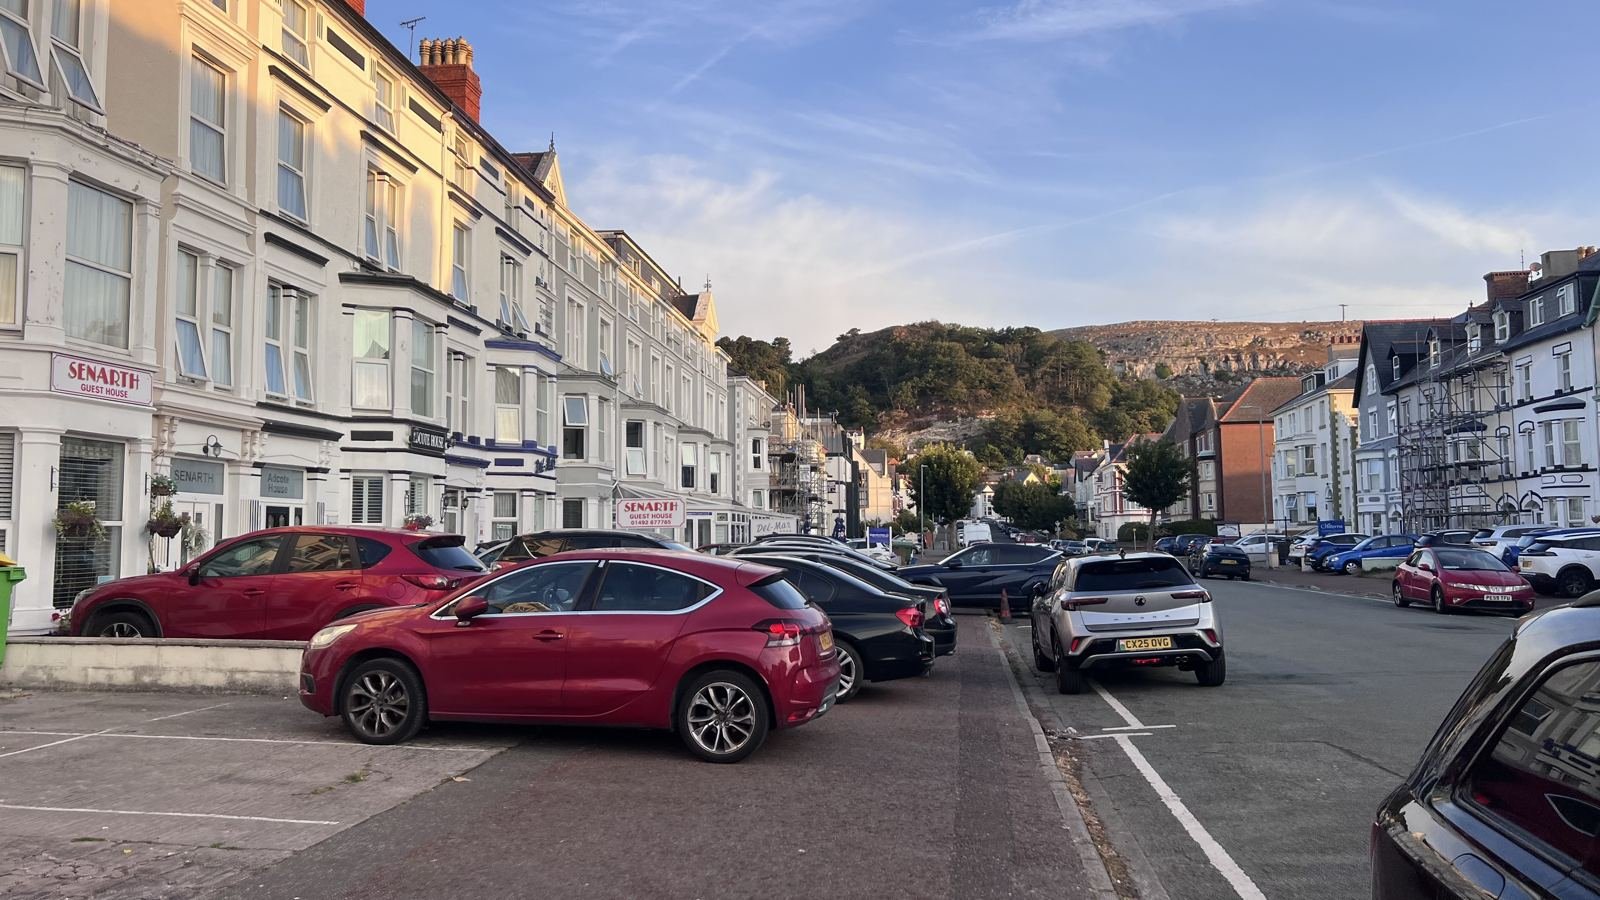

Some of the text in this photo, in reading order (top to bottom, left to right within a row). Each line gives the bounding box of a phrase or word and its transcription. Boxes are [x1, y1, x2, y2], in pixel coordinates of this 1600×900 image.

[68, 361, 140, 390] SENARTH
[80, 383, 128, 398] GUEST HOUSE
[174, 469, 214, 484] SENARTH
[267, 472, 289, 484] Adcote
[267, 483, 289, 494] House
[623, 501, 678, 512] SENARTH
[1125, 637, 1169, 649] CX25 OVG
